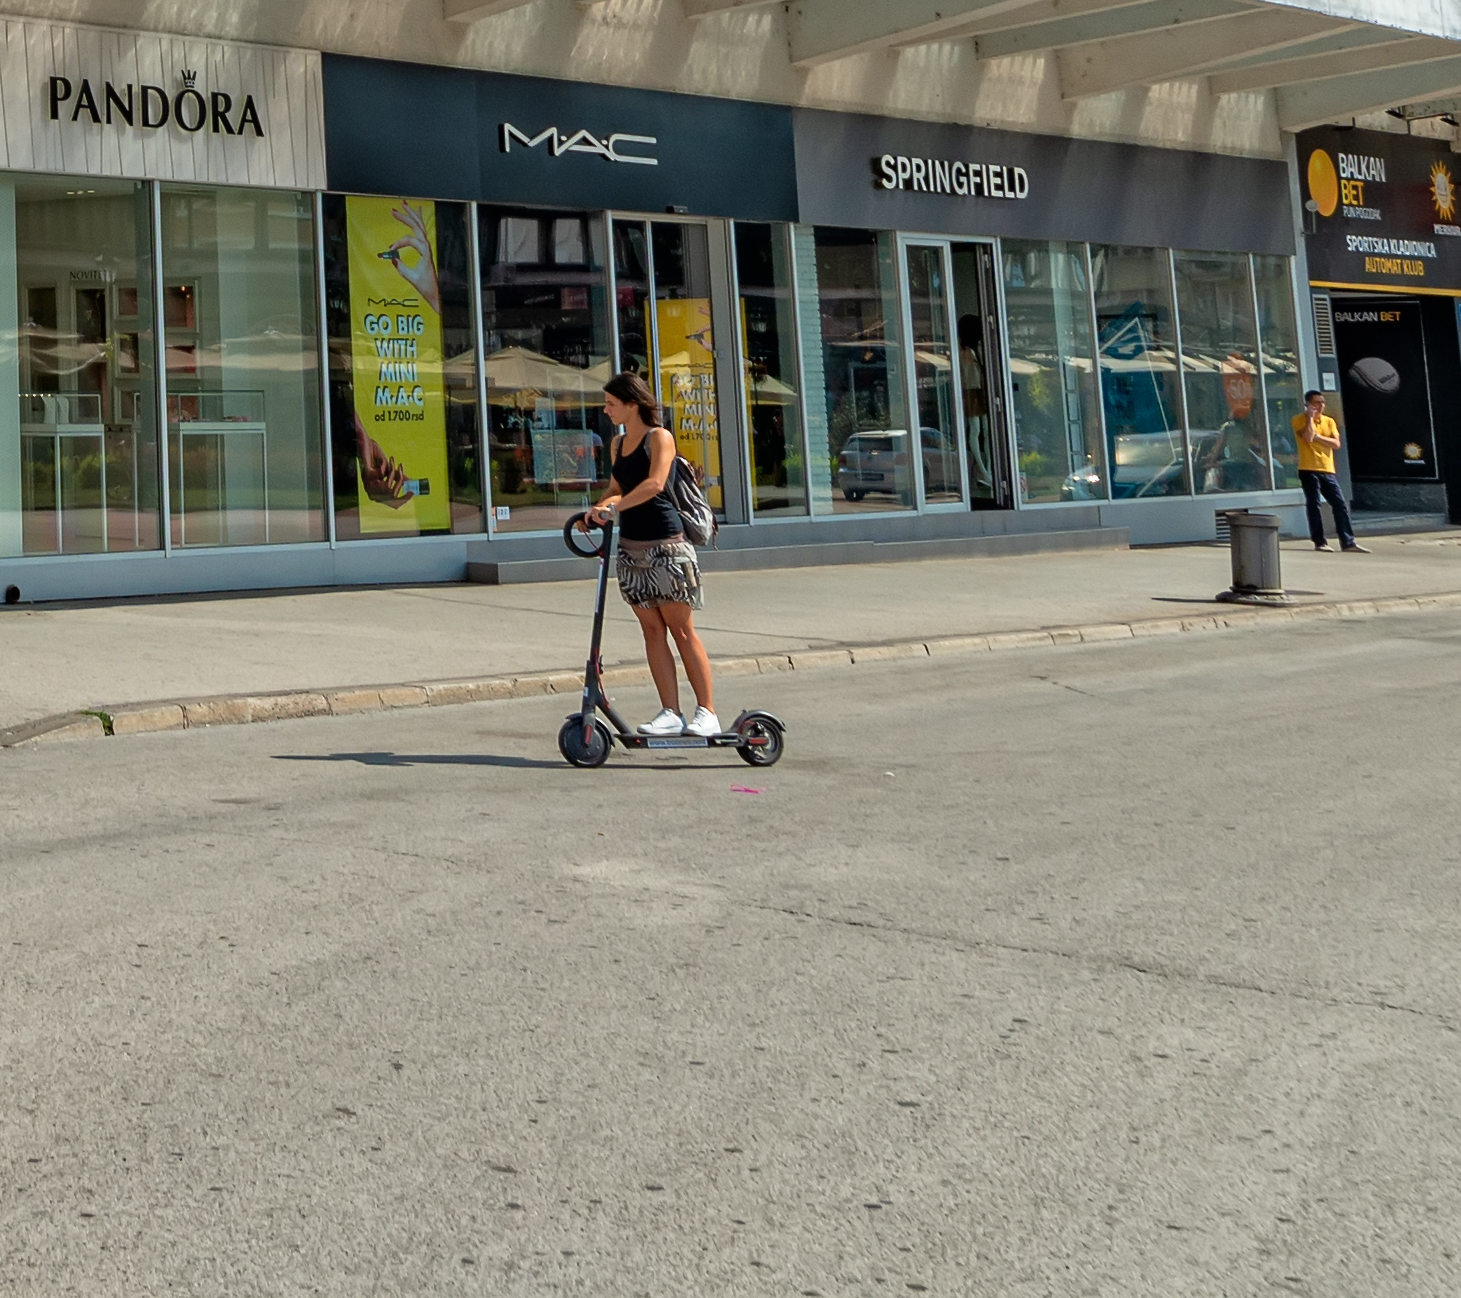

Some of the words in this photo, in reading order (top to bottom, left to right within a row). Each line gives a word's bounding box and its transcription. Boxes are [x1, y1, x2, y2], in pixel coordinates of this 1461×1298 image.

[49, 74, 266, 138] PANDORA
[879, 152, 1030, 201] SPRINGFIELD
[1338, 152, 1387, 183] BALKAN
[1340, 179, 1365, 206] BET
[1345, 234, 1389, 254] SPORTSKA
[1390, 238, 1437, 258] KLADIONICA
[1364, 256, 1402, 275] AUTOMAT
[1402, 258, 1425, 277] KLUB
[364, 313, 393, 336] GO
[396, 314, 425, 336] BIG
[1334, 311, 1379, 323] BALKAN
[1380, 311, 1401, 322] BET
[374, 338, 418, 359] WITH
[379, 361, 419, 383] MINI
[699, 374, 715, 387] BI
[374, 410, 386, 422] od
[411, 411, 425, 422] rsd
